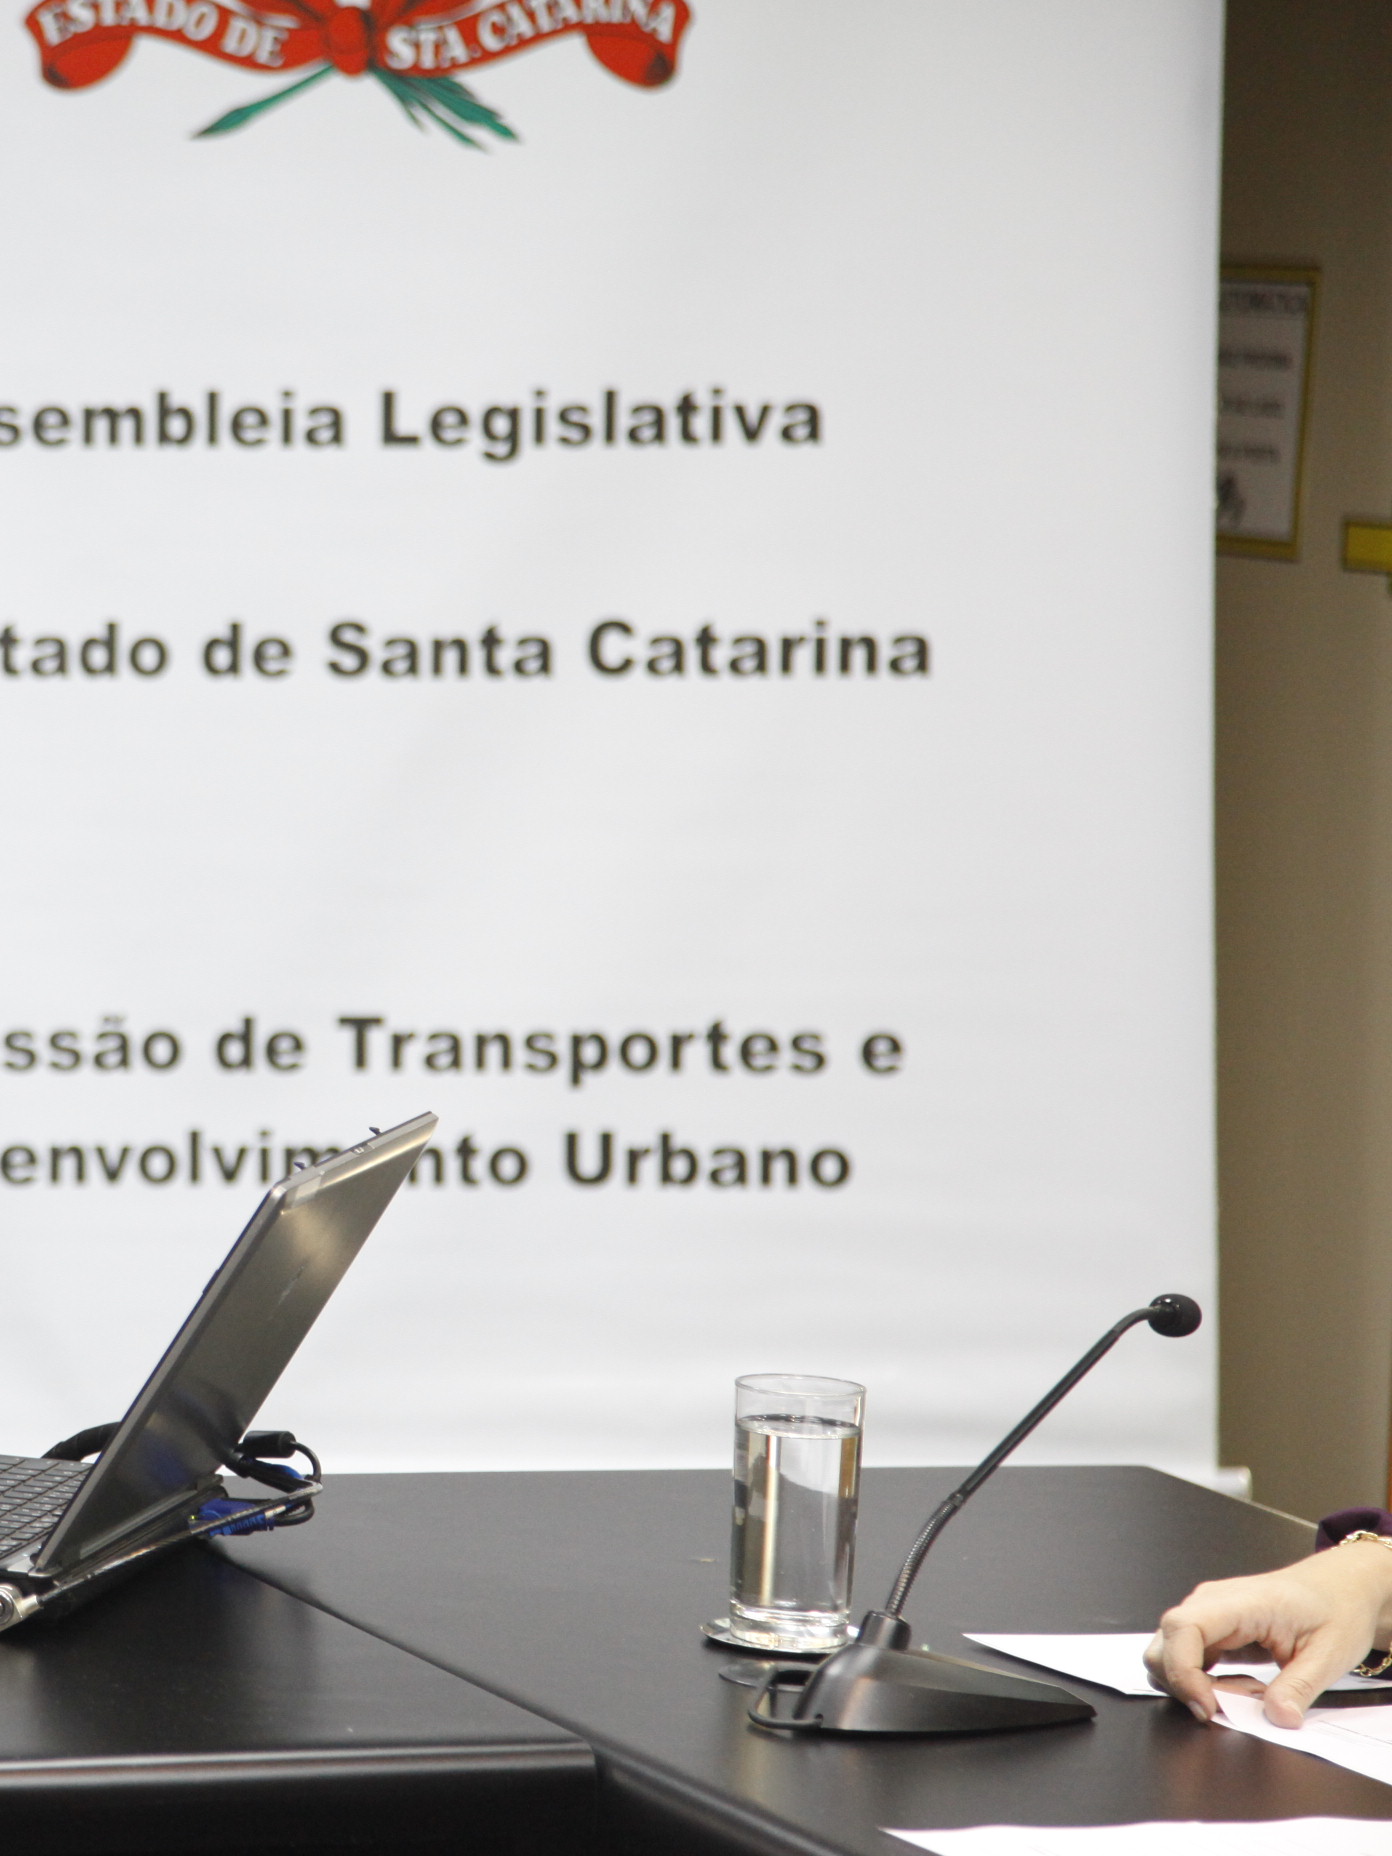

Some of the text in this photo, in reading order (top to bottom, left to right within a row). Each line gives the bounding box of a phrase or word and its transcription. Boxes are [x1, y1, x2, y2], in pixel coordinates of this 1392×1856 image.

[36, 0, 290, 68] ESTADO DE
[384, 0, 676, 71] STA. CATARINA
[381, 387, 822, 464] Legislativa
[202, 621, 293, 678] de
[327, 625, 552, 678] Santa
[587, 619, 930, 677] Catarina
[215, 1016, 305, 1072] de
[337, 1015, 827, 1088] Transportes
[860, 1032, 903, 1075] e
[564, 1130, 852, 1189] Urbano
